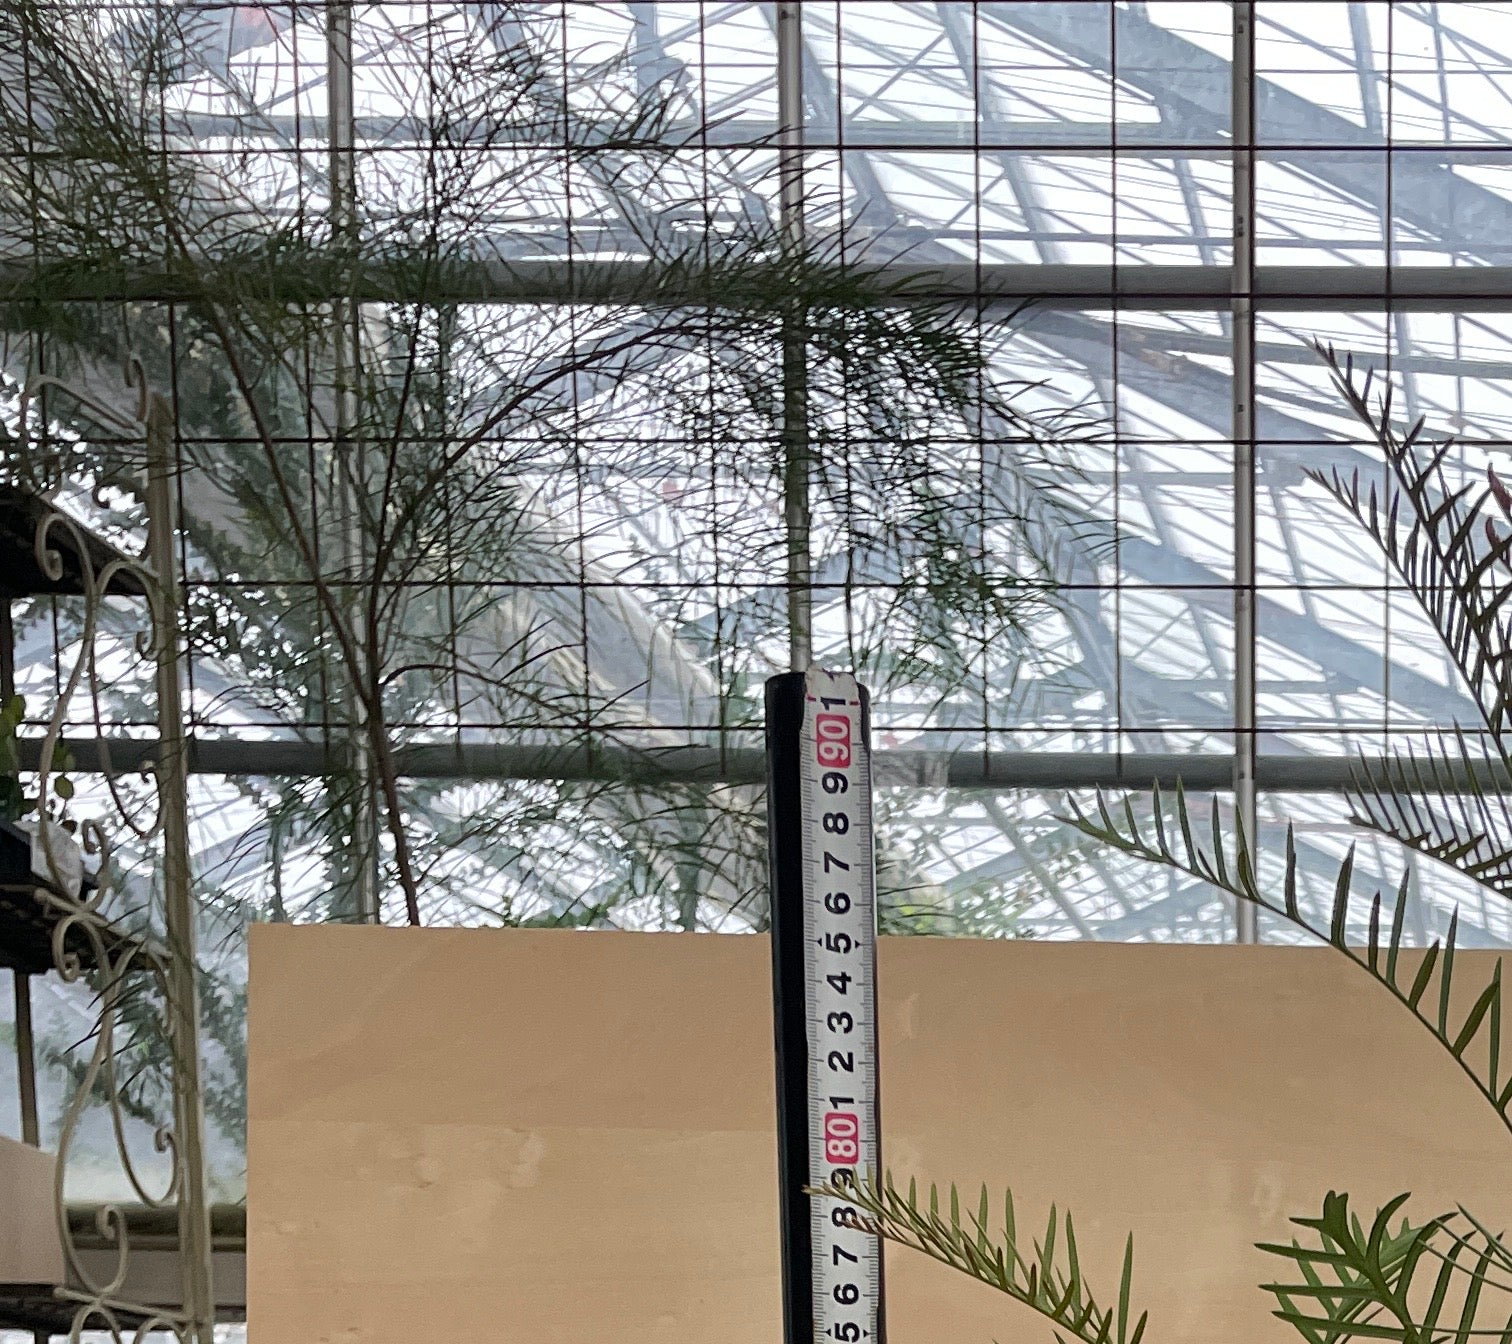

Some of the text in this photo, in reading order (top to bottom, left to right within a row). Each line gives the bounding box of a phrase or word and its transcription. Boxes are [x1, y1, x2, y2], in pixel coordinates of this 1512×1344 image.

[820, 696, 847, 711] 1
[820, 718, 848, 760] 90
[821, 771, 849, 795] 9
[822, 812, 850, 836] 8
[823, 851, 850, 874] 7
[824, 892, 851, 915] 6
[825, 932, 852, 954] 5
[826, 971, 852, 995] 4
[826, 1011, 854, 1034] 3
[827, 1050, 854, 1073] 2
[829, 1096, 855, 1110] 1
[828, 1120, 856, 1157] 80
[831, 1206, 857, 1229] 8
[832, 1244, 859, 1266] 7
[833, 1283, 859, 1305] 6
[834, 1321, 860, 1344] 5
